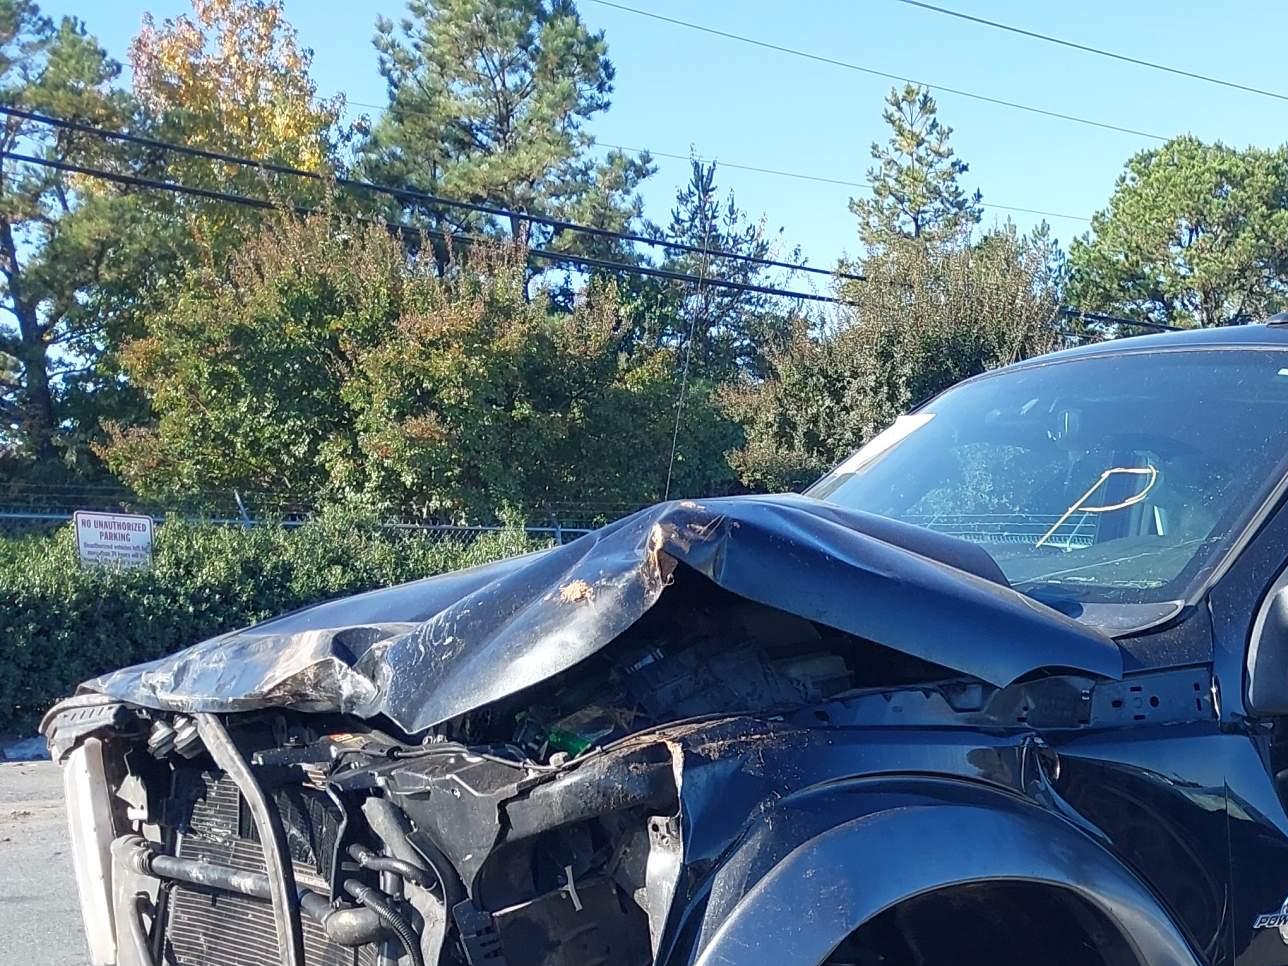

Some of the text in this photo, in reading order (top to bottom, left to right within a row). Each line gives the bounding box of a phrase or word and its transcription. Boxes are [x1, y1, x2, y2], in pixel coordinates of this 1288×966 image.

[81, 519, 147, 532] NO UNAUTHORIZED
[99, 531, 131, 542] PARKING
